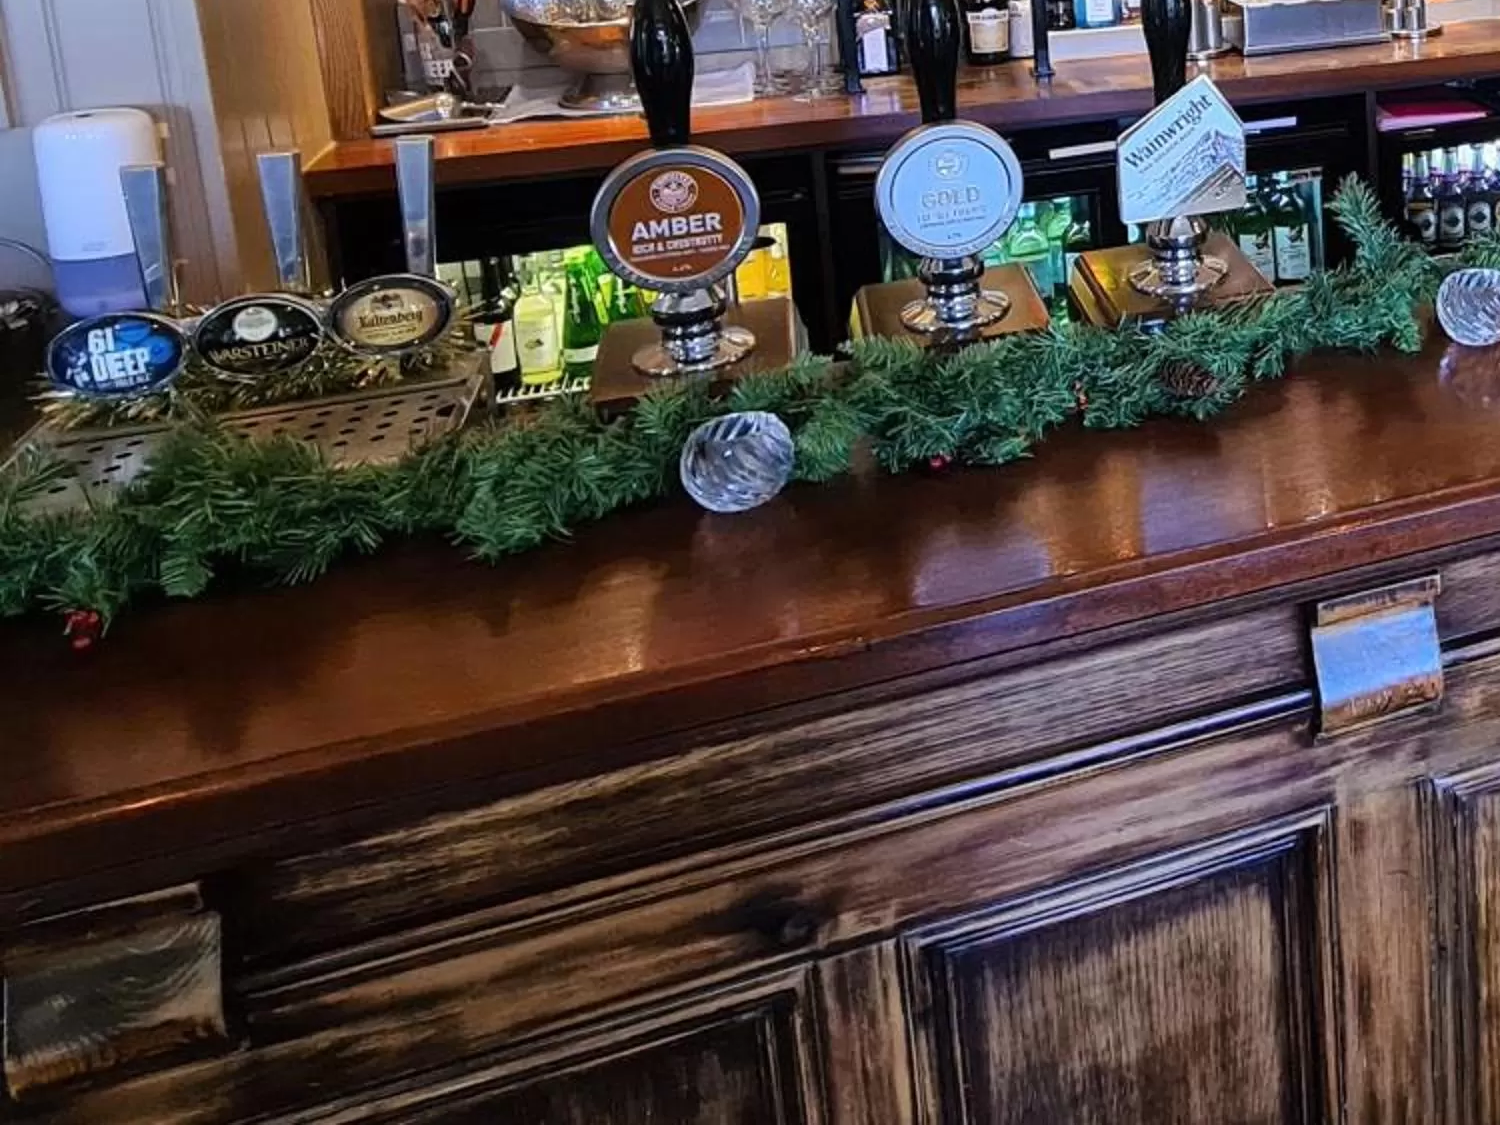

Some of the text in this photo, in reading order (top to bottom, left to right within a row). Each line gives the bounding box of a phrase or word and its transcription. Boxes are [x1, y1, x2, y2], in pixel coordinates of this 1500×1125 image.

[1123, 93, 1214, 169] Wainwright
[922, 185, 980, 209] GOLD
[632, 213, 722, 241] AMBER
[90, 346, 151, 382] DEEP
[208, 337, 310, 364] WARSTEINER
